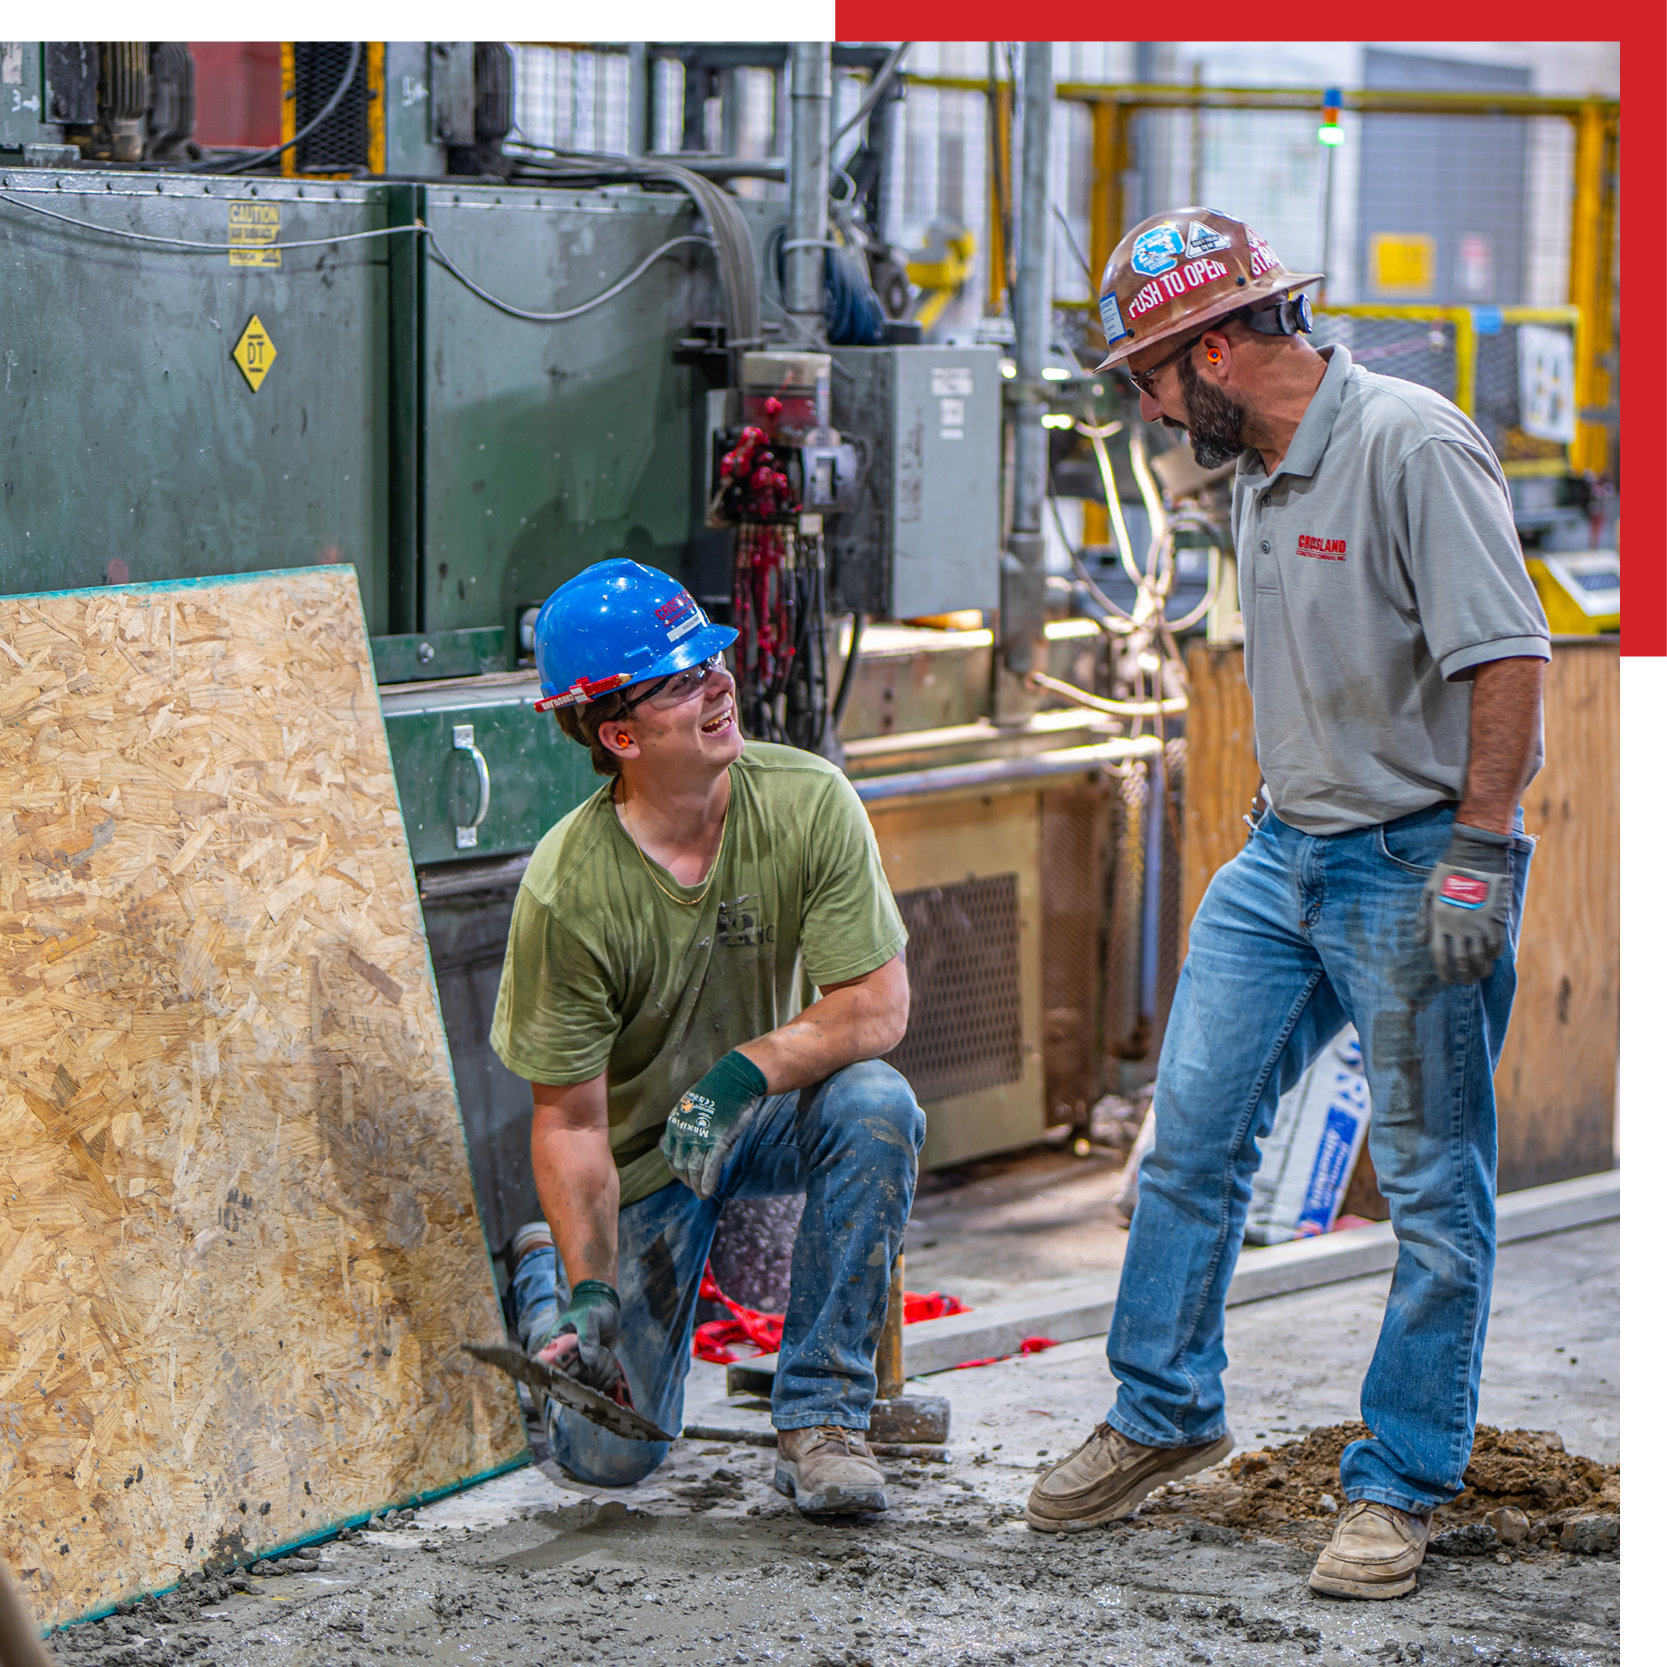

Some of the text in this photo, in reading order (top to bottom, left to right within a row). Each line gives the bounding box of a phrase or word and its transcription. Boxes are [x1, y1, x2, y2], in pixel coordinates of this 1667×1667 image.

[230, 204, 280, 223] CAUTION
[1128, 258, 1228, 318] PUSH TO OPEN
[248, 342, 265, 364] DT
